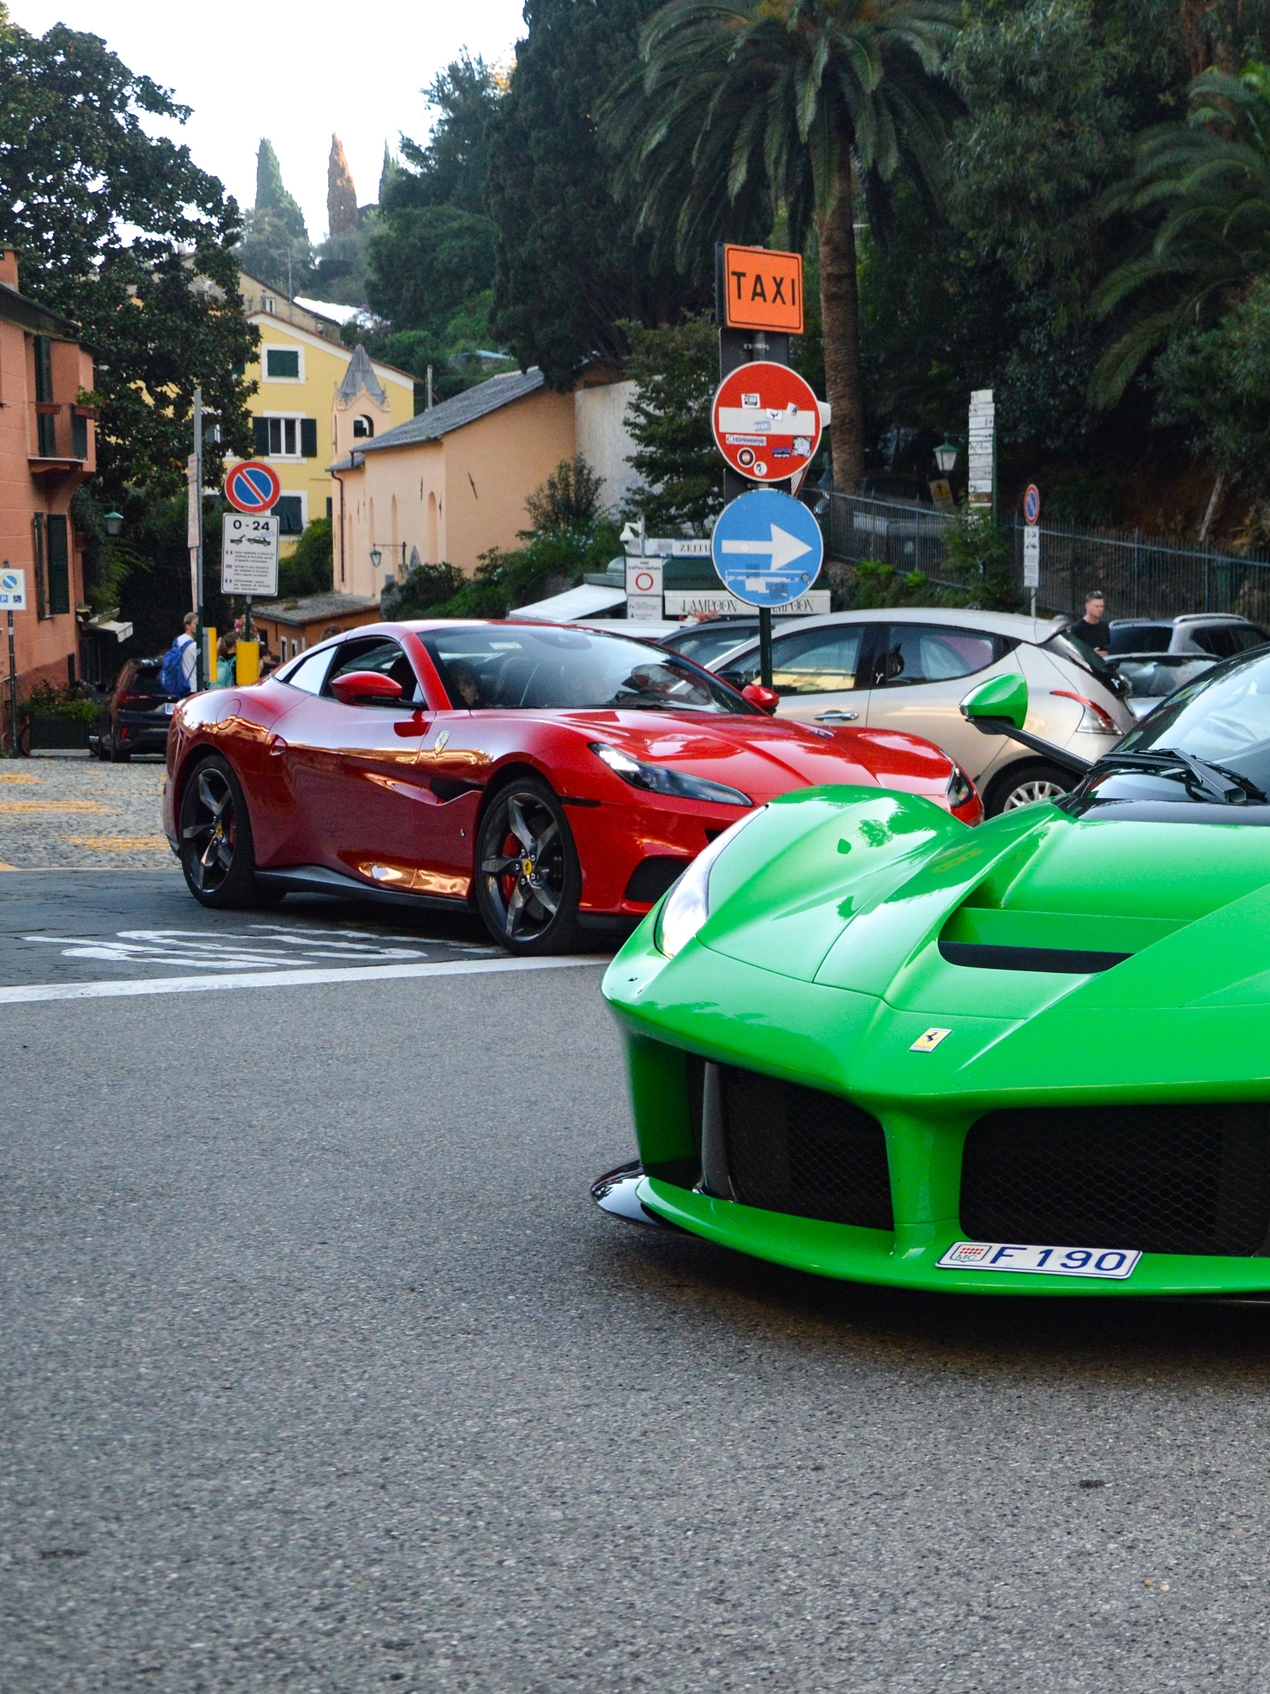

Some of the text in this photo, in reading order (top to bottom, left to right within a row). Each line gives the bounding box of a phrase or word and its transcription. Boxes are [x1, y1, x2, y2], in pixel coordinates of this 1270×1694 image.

[731, 271, 796, 306] TAXI
[252, 521, 270, 531] 24
[681, 599, 737, 613] LAMPOON
[955, 1254, 978, 1262] MC
[989, 1246, 1127, 1272] F 190
